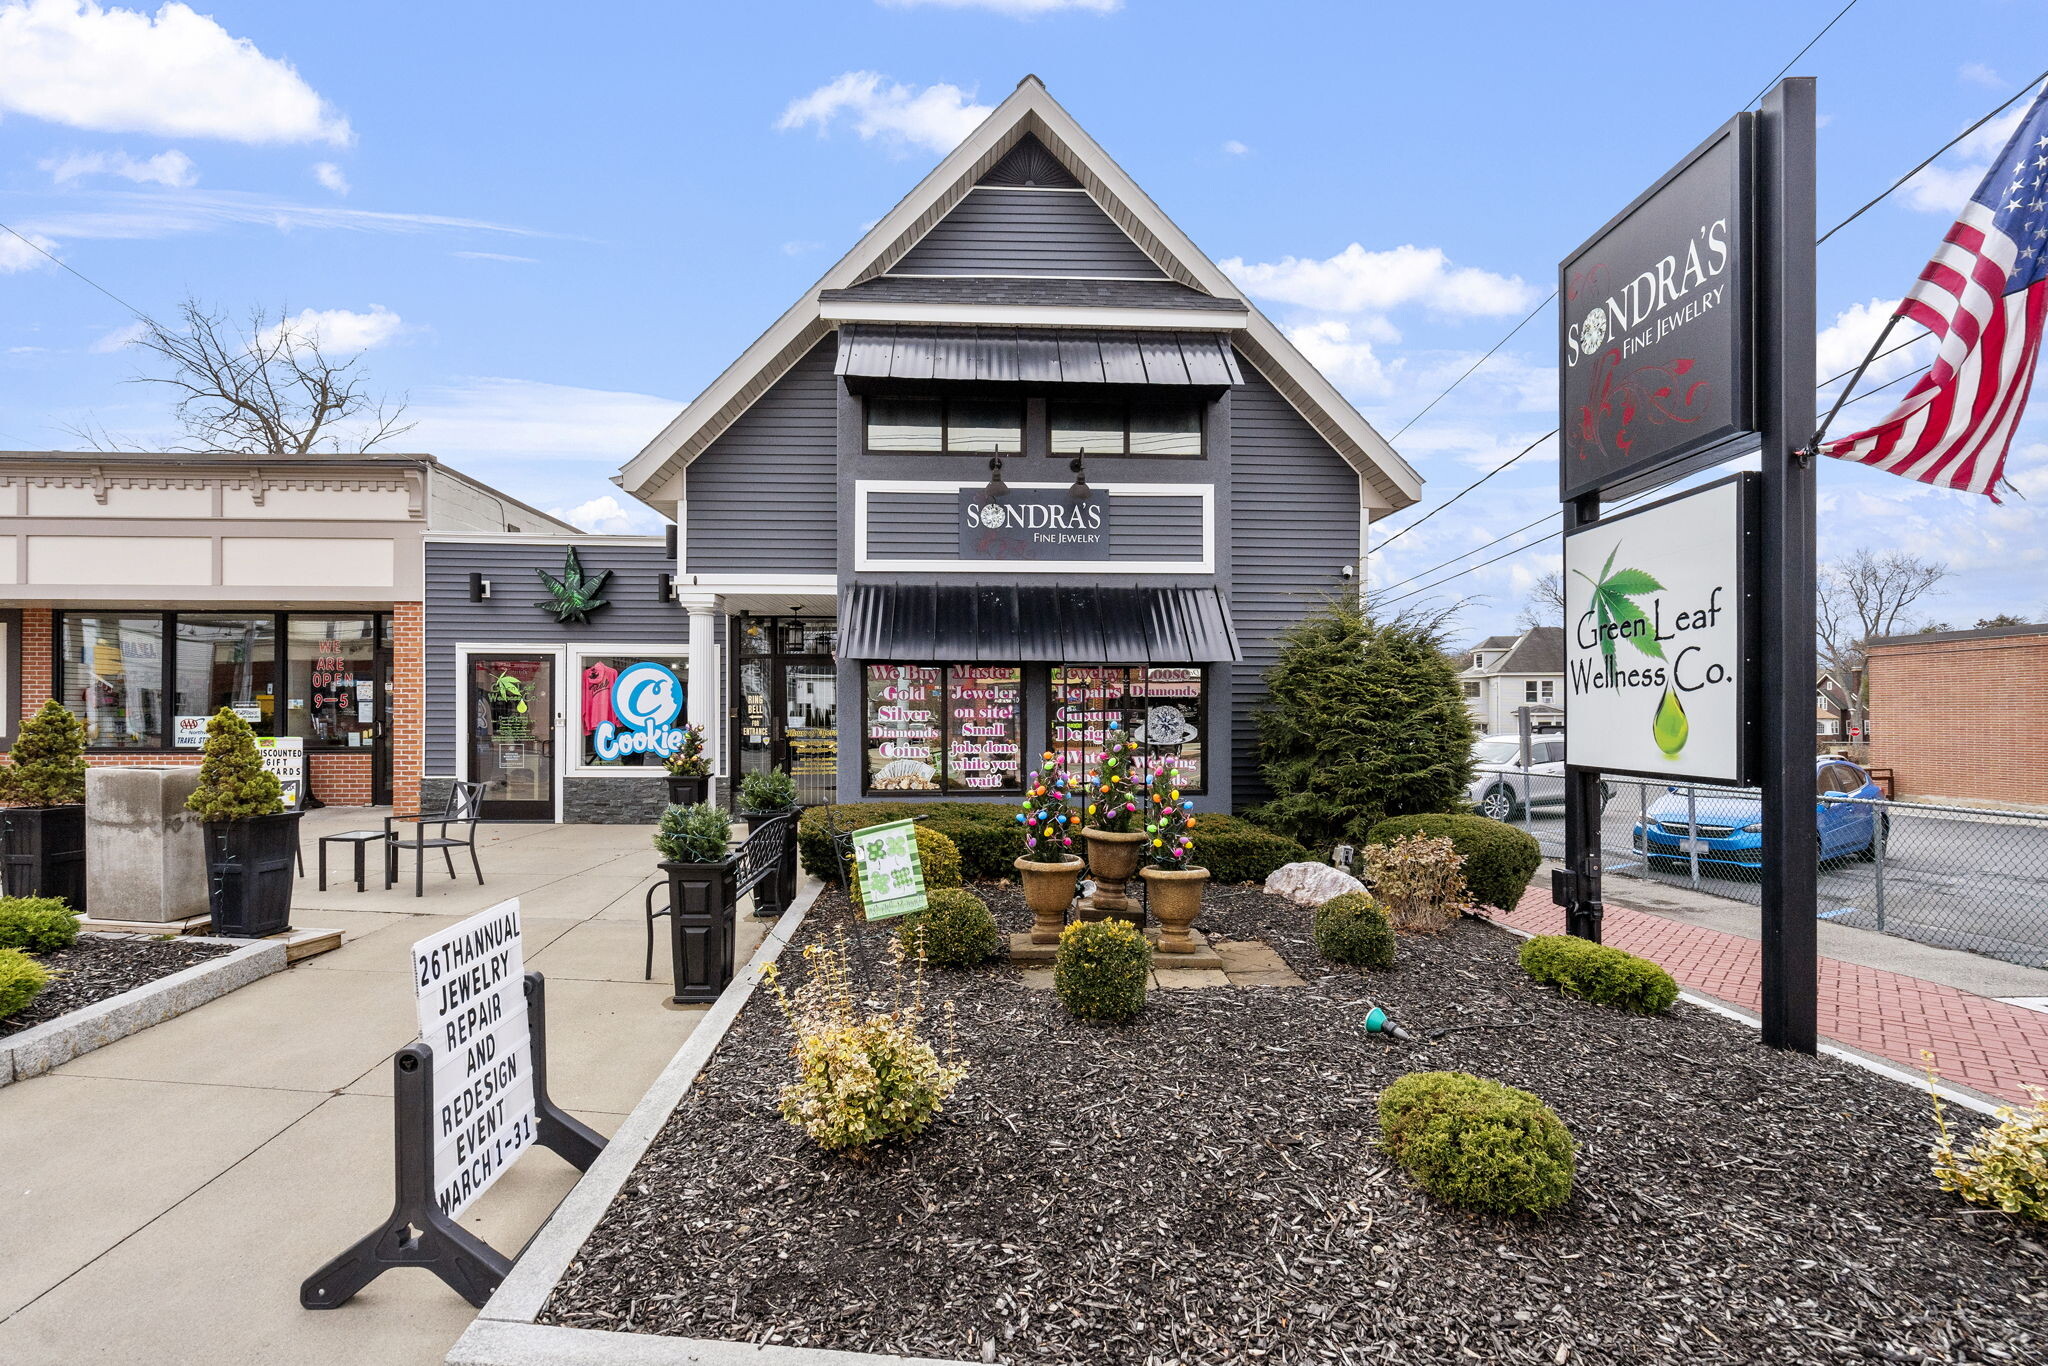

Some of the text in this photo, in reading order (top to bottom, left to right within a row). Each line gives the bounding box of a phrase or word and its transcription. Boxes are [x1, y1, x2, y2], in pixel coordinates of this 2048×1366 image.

[1622, 284, 1725, 360] FINE JEWELRY
[1033, 532, 1101, 544] FINE JEWELRY
[1576, 586, 1723, 650] Green Leaf
[319, 640, 341, 653] WE
[316, 657, 344, 671] ARE
[952, 664, 1015, 680] Master
[1570, 645, 1733, 696] Wellness Co.
[312, 672, 354, 687] OPEN
[870, 664, 940, 683] We Buy
[1055, 665, 1120, 683] Jewelry
[747, 695, 764, 704] RING
[883, 686, 926, 700] Gold
[951, 685, 1017, 700] Jeweler
[1056, 684, 1123, 700] Repairs
[748, 705, 763, 714] BELL
[877, 705, 931, 722] Silver
[954, 705, 1013, 719] on site!
[742, 728, 769, 736] ENTRANCE
[869, 726, 940, 738] Diamonds
[962, 722, 1005, 737] Small
[594, 717, 687, 761] Cookie
[260, 749, 302, 757] ISCOUNTED
[879, 742, 931, 758] Coins
[951, 740, 1018, 756] jobs done
[266, 758, 287, 766] GIFT
[951, 757, 1018, 774] while you
[966, 773, 1003, 788] wait!
[439, 950, 509, 1016] JEWELRY
[446, 993, 502, 1052] REPAIR
[467, 1033, 496, 1078] AND
[441, 1052, 517, 1137] REDESIGN
[456, 1098, 504, 1166] EVENT
[439, 1114, 531, 1217] MARCH 1-31
